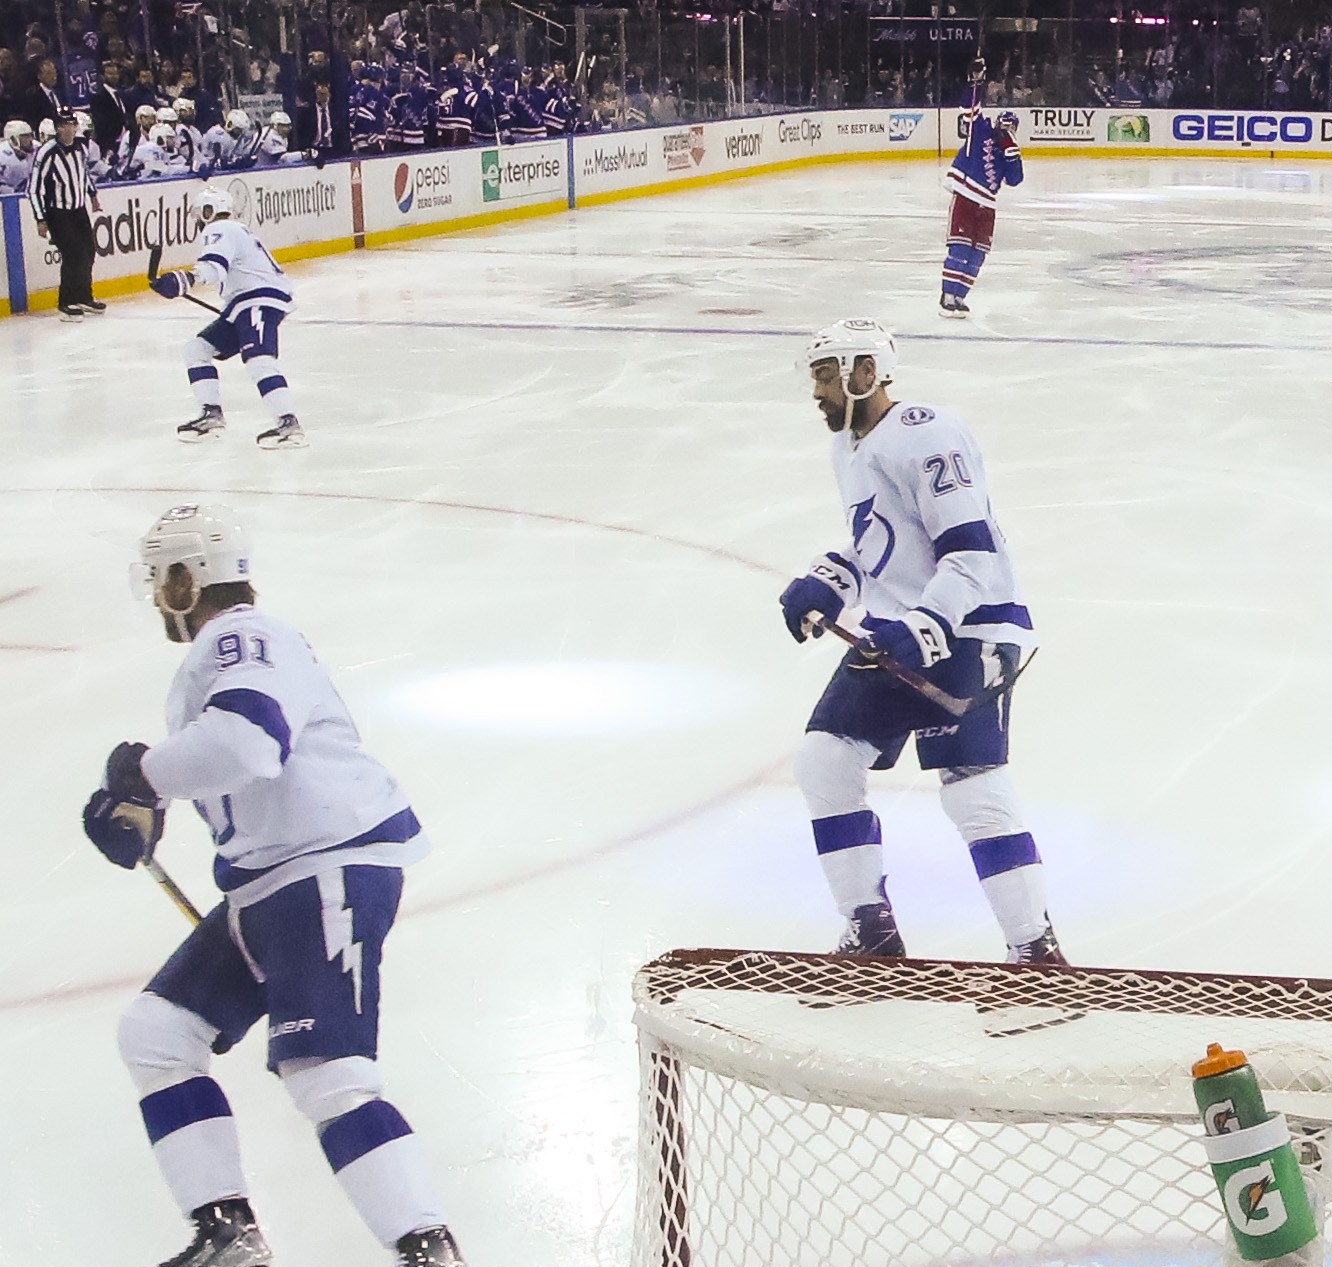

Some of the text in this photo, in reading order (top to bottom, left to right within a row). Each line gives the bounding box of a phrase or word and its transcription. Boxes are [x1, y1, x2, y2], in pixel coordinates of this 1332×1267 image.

[929, 28, 973, 41] ULTRA
[779, 118, 822, 147] Great Clips
[837, 124, 848, 135] THE
[869, 123, 885, 133] RUN
[889, 117, 916, 137] SAP
[1030, 110, 1096, 127] TRULY
[1173, 115, 1313, 142] GEICO
[725, 127, 760, 159] verizon
[594, 143, 648, 175] MassMutual
[415, 159, 451, 189] pepsi
[418, 195, 452, 209] ZERO SUGAR
[204, 232, 223, 246] 17
[922, 450, 974, 498] 20
[215, 630, 276, 673] 91
[1223, 1158, 1290, 1237] G
